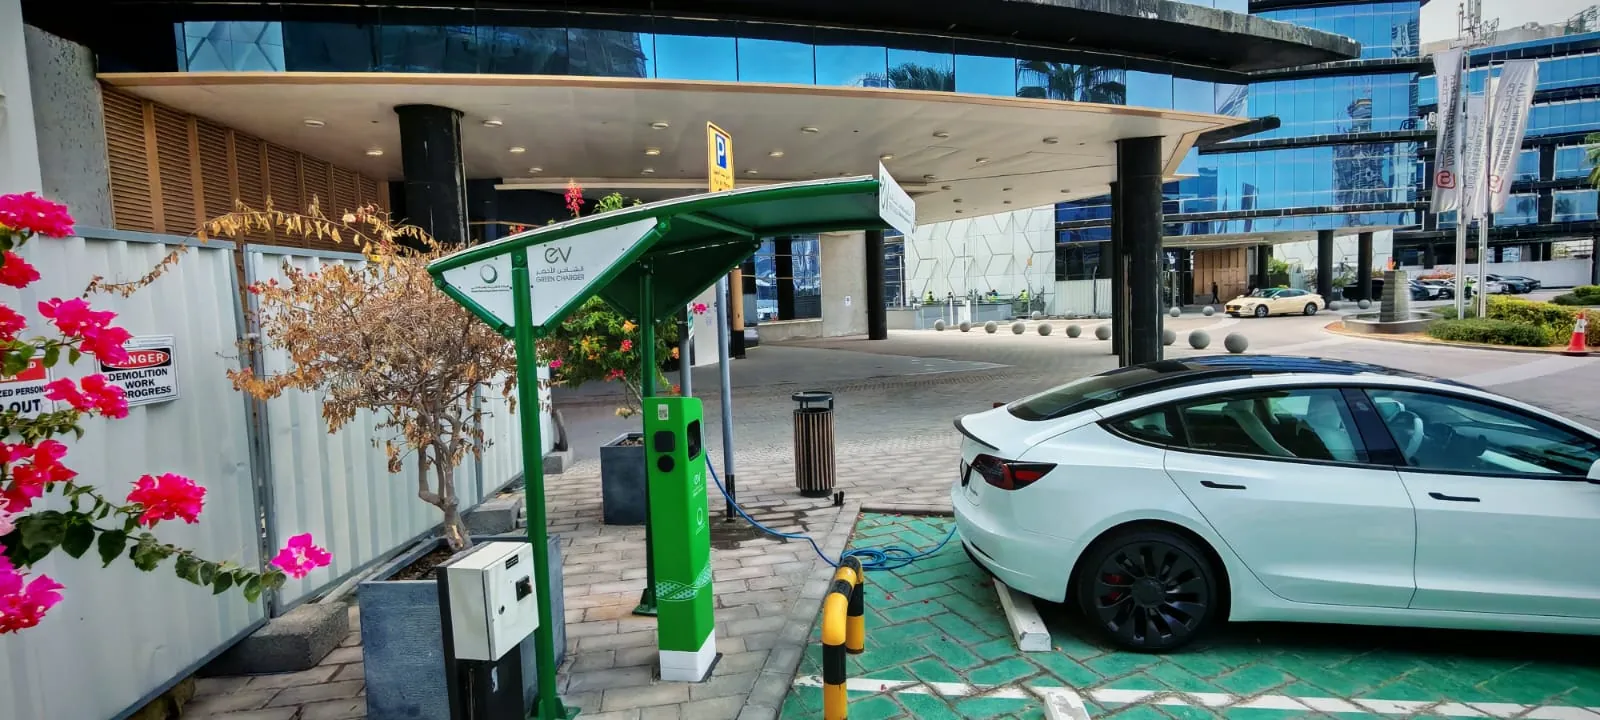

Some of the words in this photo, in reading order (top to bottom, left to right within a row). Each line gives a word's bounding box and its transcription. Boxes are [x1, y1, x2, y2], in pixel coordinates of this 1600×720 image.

[717, 135, 725, 165] P
[118, 353, 164, 366] NGER
[108, 368, 168, 382] DEMOLITION
[125, 378, 155, 390] WORK
[10, 398, 41, 414] OUT
